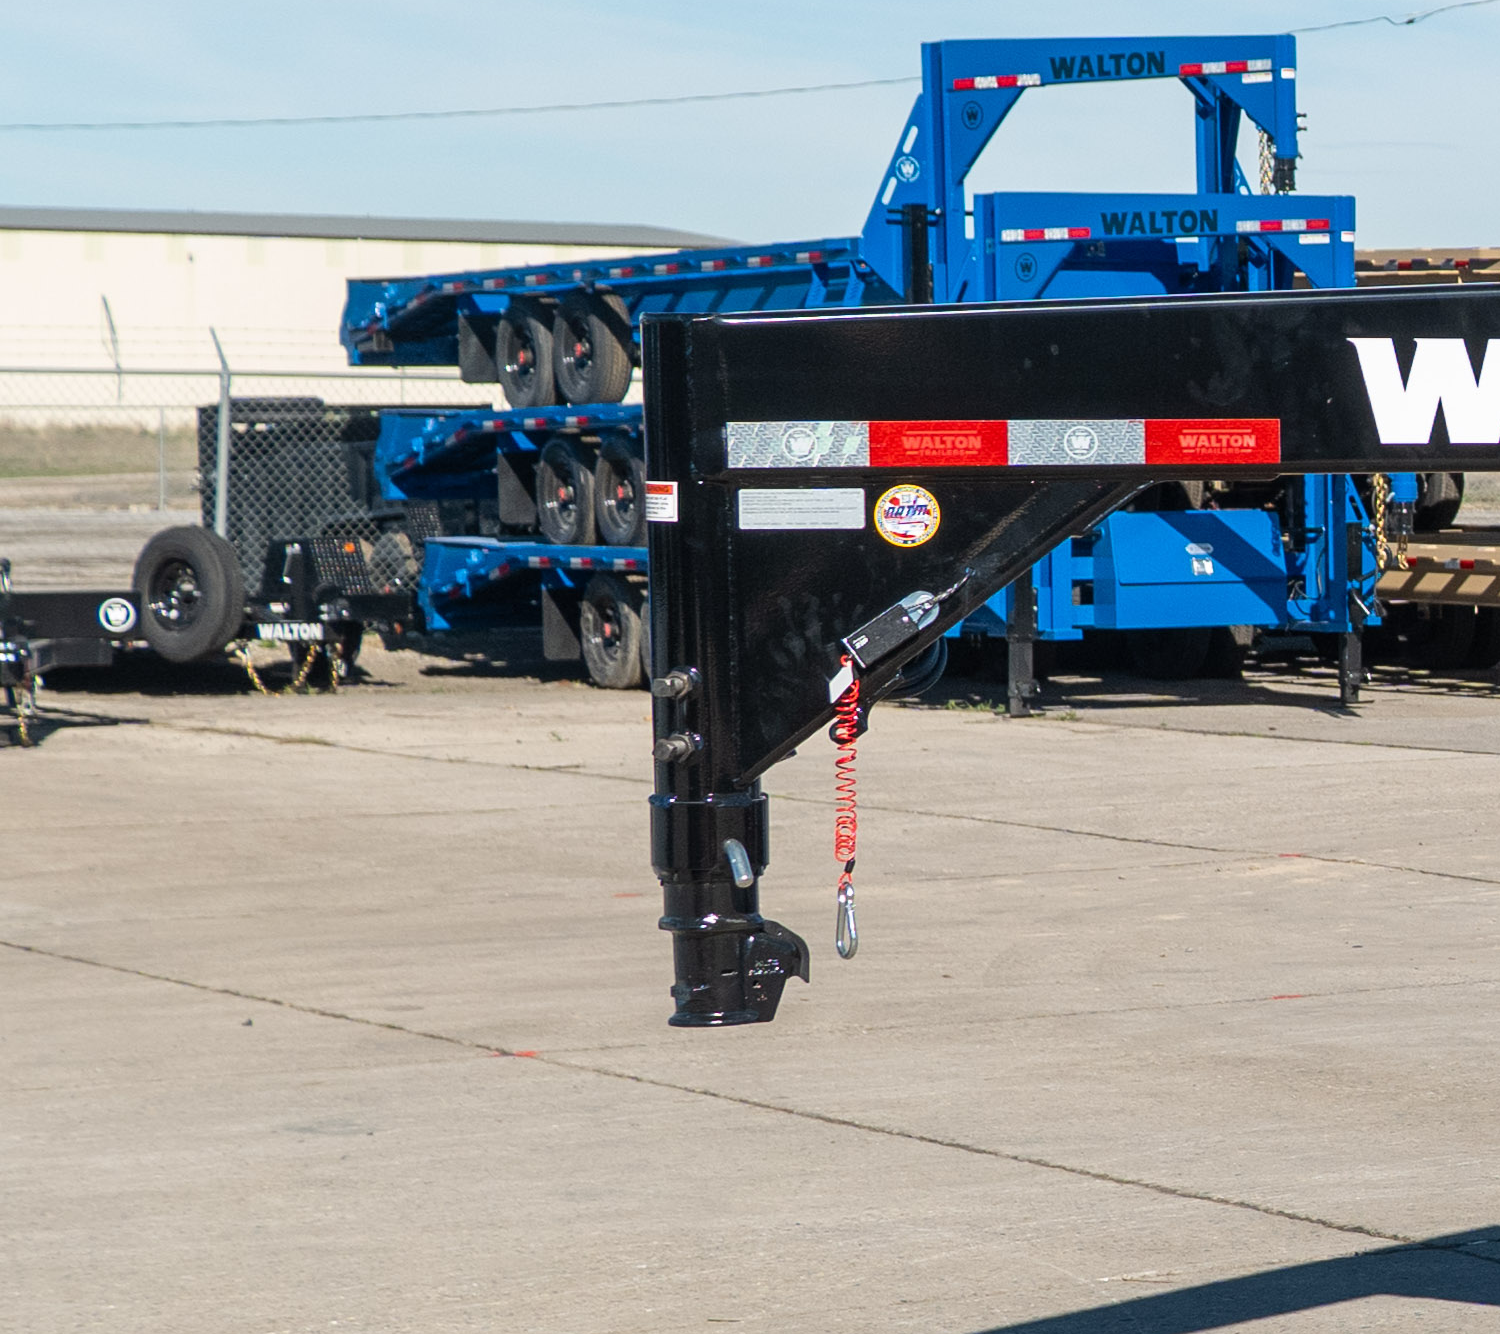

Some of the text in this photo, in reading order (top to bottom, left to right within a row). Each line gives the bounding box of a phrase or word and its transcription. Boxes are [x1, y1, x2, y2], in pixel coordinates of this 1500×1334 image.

[1049, 51, 1166, 79] WALTON
[1101, 209, 1219, 236] WALTON
[901, 434, 983, 450] WALTON
[1178, 434, 1257, 448] WALTON
[257, 623, 324, 641] WALTON
